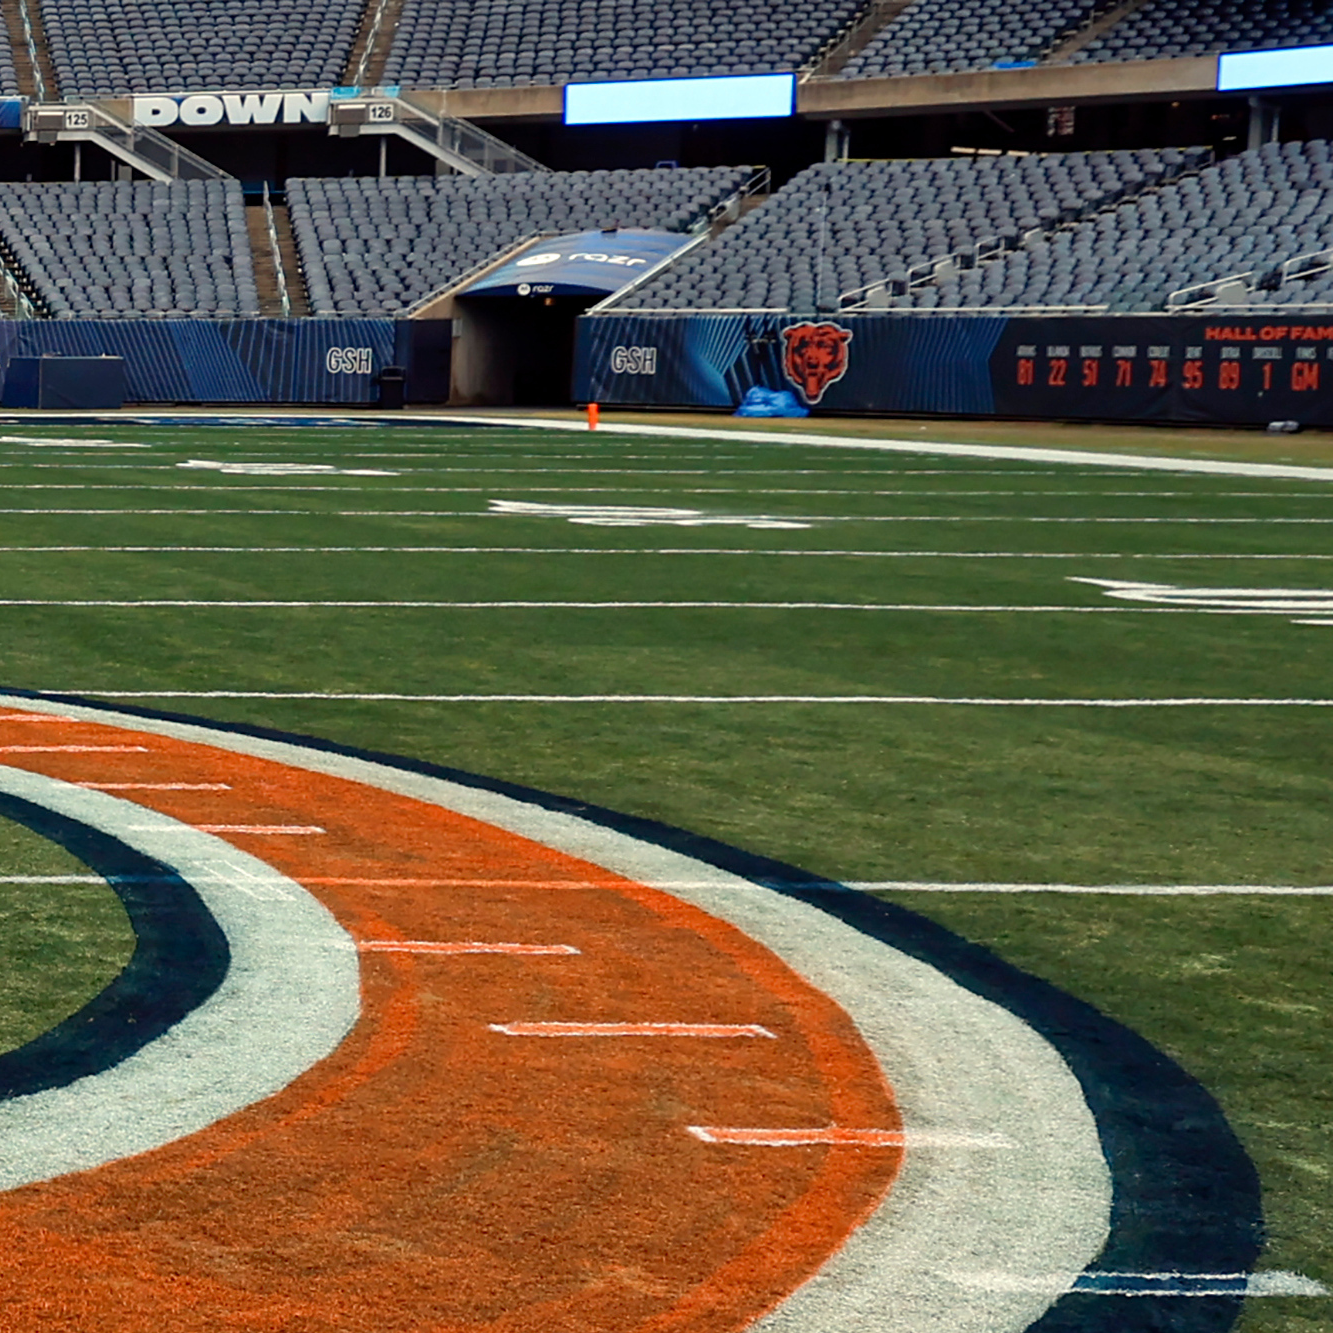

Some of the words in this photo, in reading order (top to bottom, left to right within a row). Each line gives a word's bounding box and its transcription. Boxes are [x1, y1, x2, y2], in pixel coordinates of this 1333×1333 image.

[134, 93, 329, 126] DOWN
[371, 106, 392, 118] 126
[67, 114, 87, 125] 125
[568, 252, 647, 266] razr
[532, 284, 554, 293] razr
[1204, 327, 1257, 341] HALL
[1259, 326, 1288, 340] OF
[326, 347, 373, 374] GSH
[611, 346, 657, 375] GSH
[1048, 359, 1067, 386] 22
[1116, 359, 1132, 387] 71
[1262, 362, 1273, 390] 1
